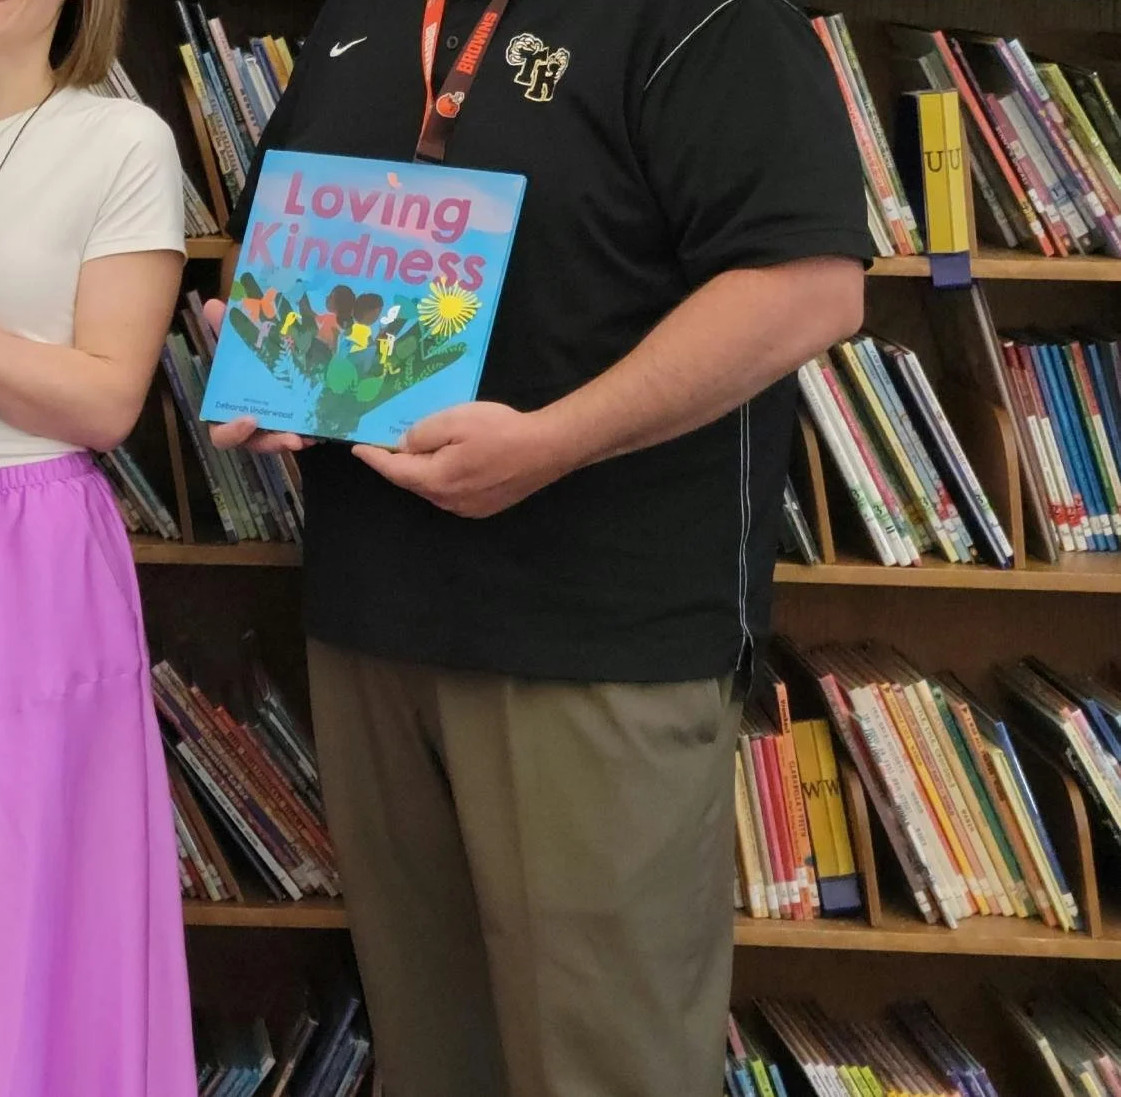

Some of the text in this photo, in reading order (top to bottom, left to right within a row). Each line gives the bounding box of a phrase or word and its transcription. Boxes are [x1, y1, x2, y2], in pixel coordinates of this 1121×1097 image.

[457, 11, 498, 75] BROWNS
[284, 171, 471, 243] Loving
[246, 222, 487, 291] Kindness
[215, 401, 248, 412] Deborah
